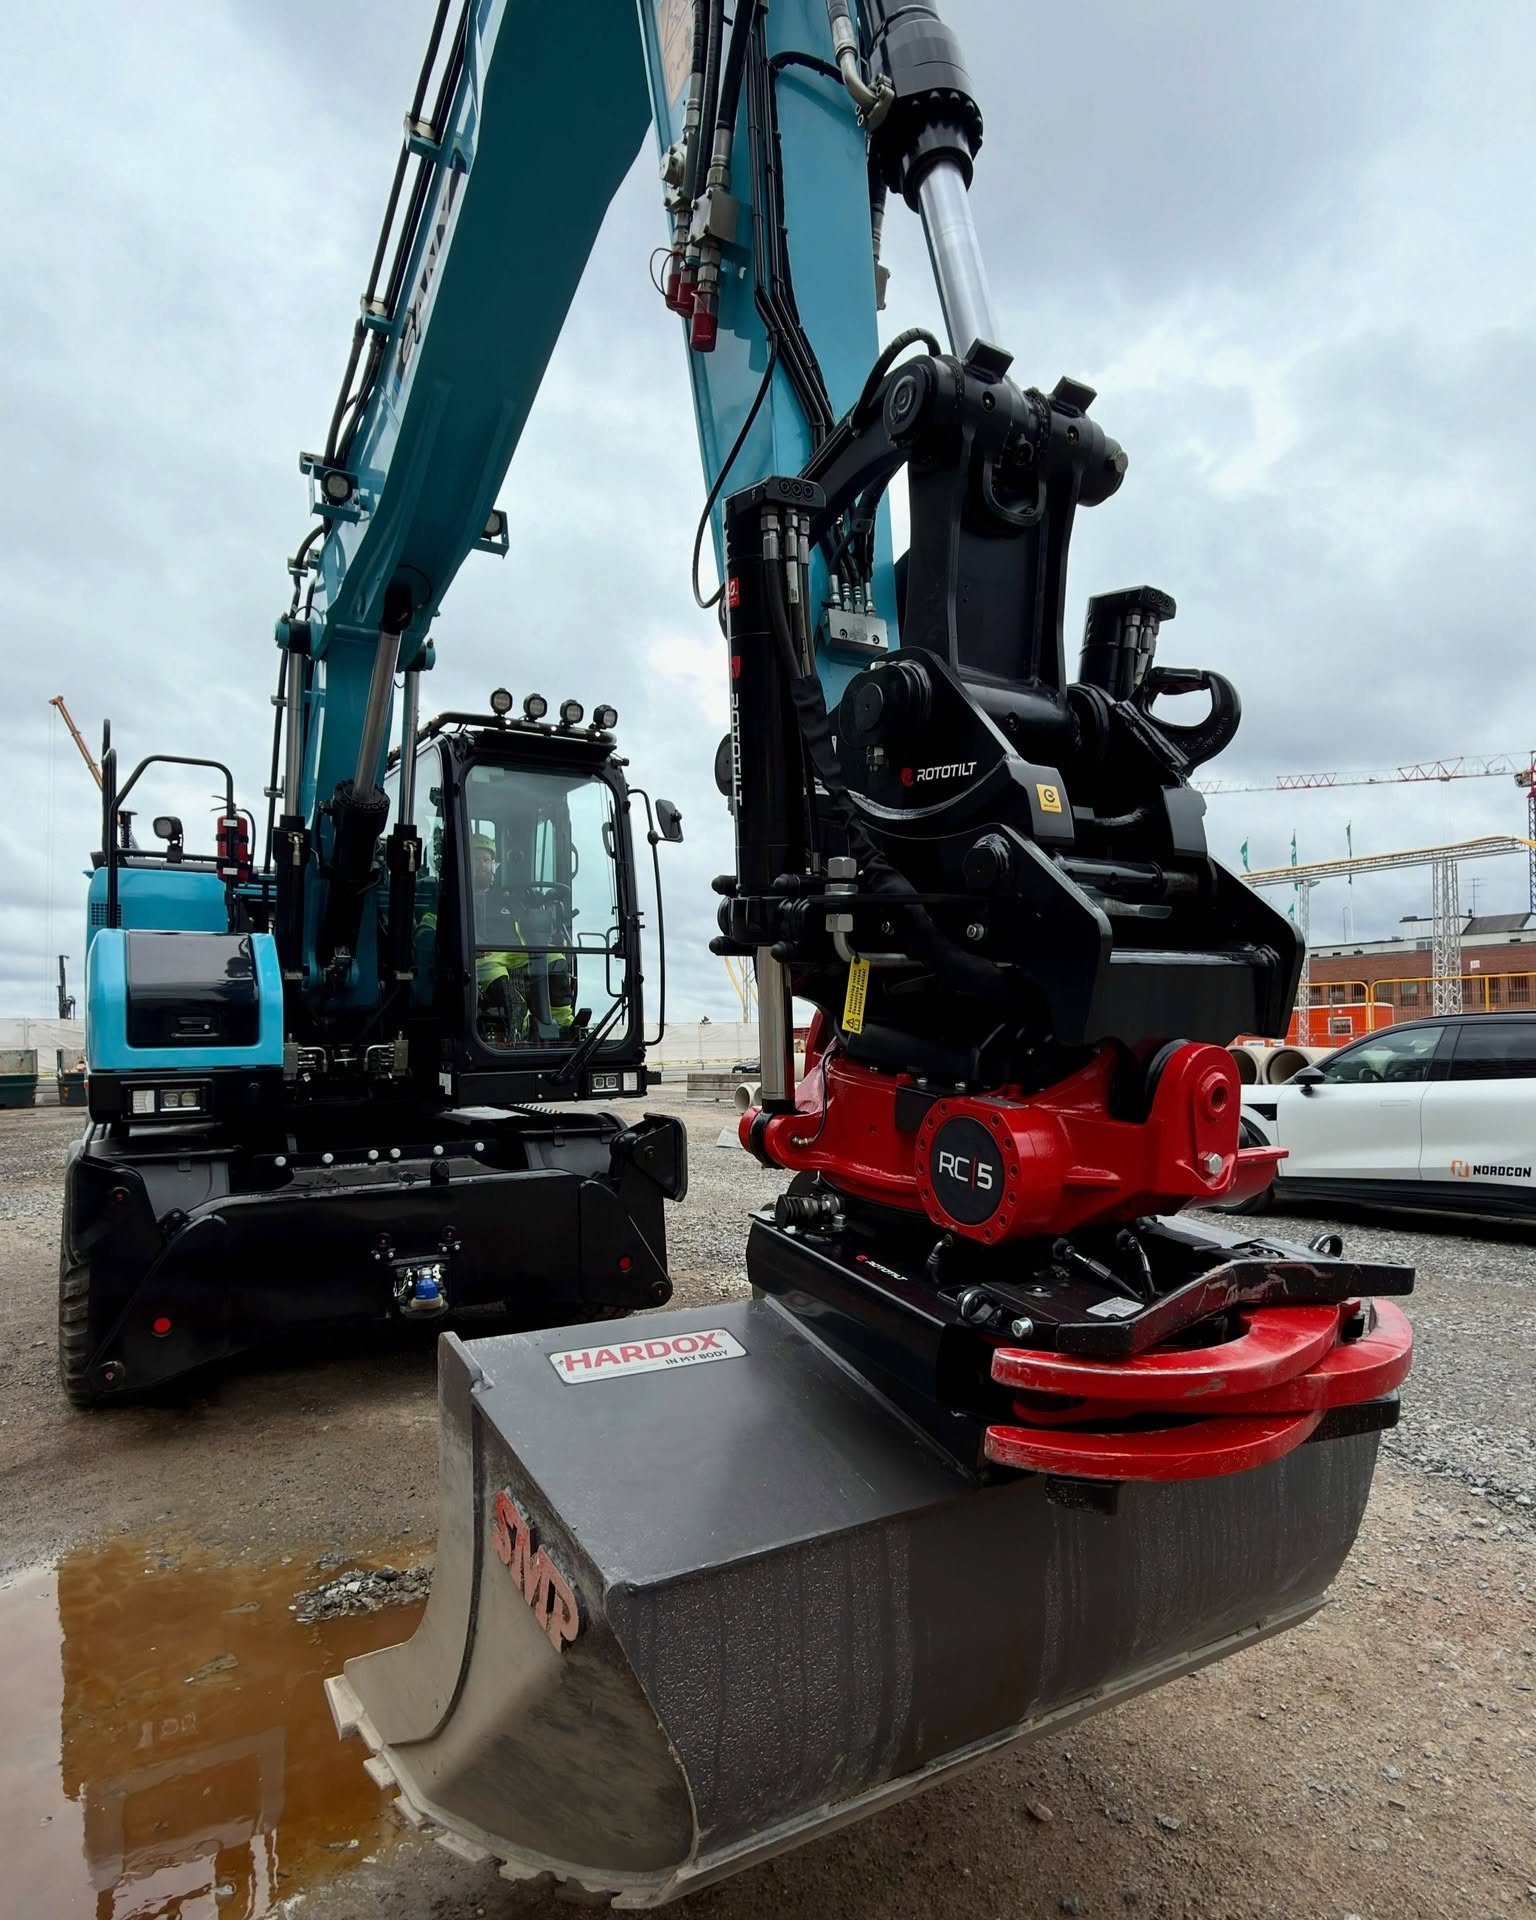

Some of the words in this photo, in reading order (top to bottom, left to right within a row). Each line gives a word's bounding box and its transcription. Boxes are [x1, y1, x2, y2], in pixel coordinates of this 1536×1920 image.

[731, 692, 743, 806] ROTOTILT
[916, 761, 977, 782] ROTOTILT
[1473, 1165, 1532, 1178] NORDCON
[564, 1332, 723, 1372] HARDOX
[681, 1355, 696, 1363] MY
[700, 1349, 729, 1361] BODY
[492, 1489, 579, 1654] SMP
